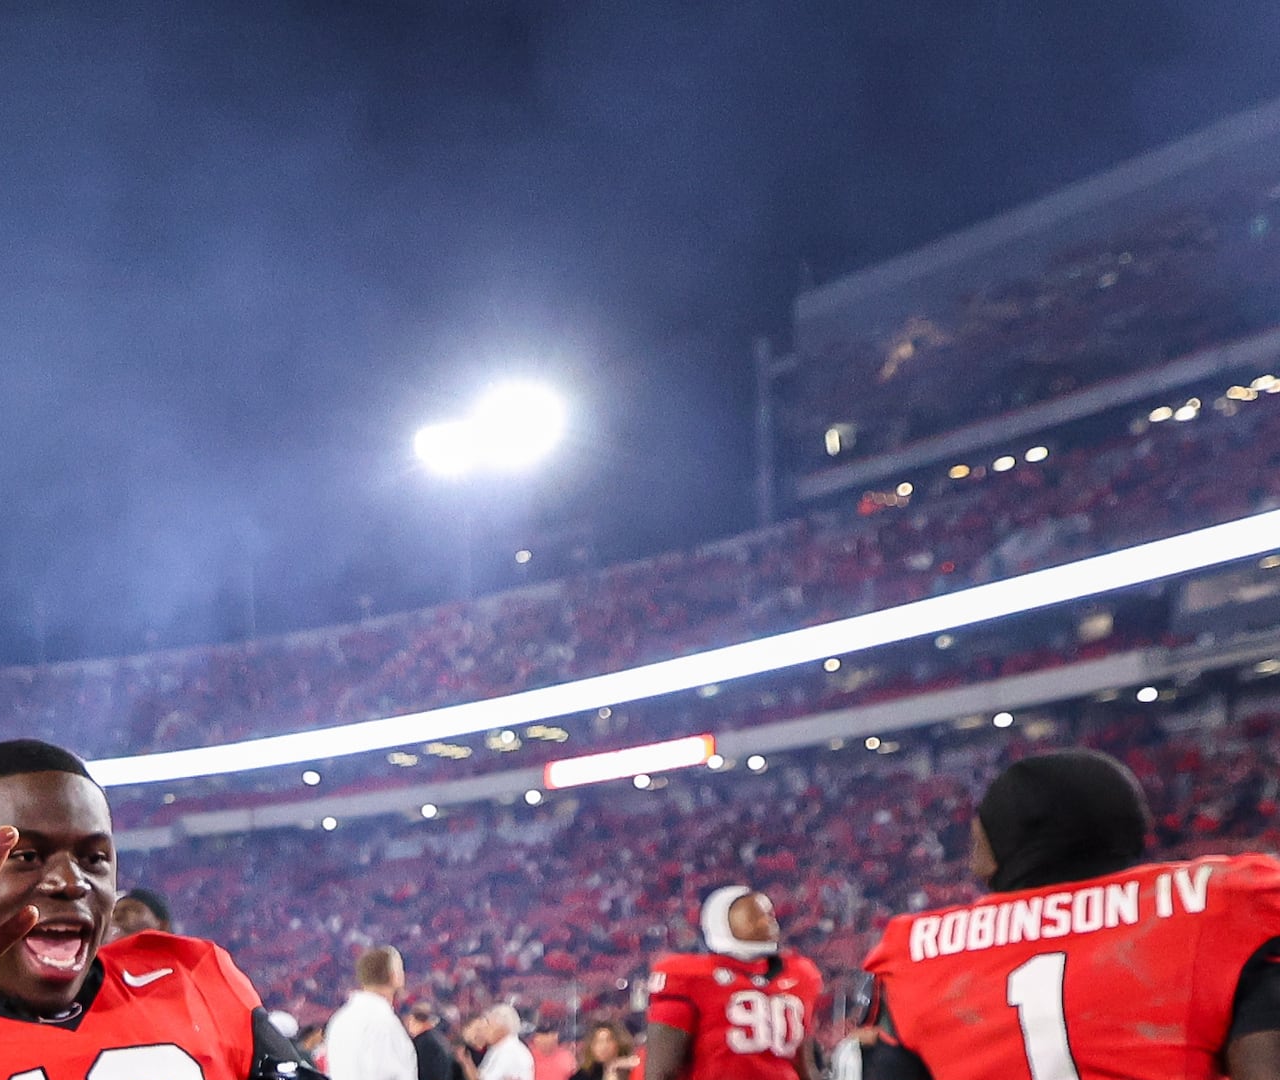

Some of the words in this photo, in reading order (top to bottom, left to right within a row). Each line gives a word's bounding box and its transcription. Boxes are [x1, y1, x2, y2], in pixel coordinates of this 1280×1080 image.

[909, 881, 1140, 963] ROBINSON
[1154, 864, 1213, 919] IV
[725, 989, 805, 1059] 90
